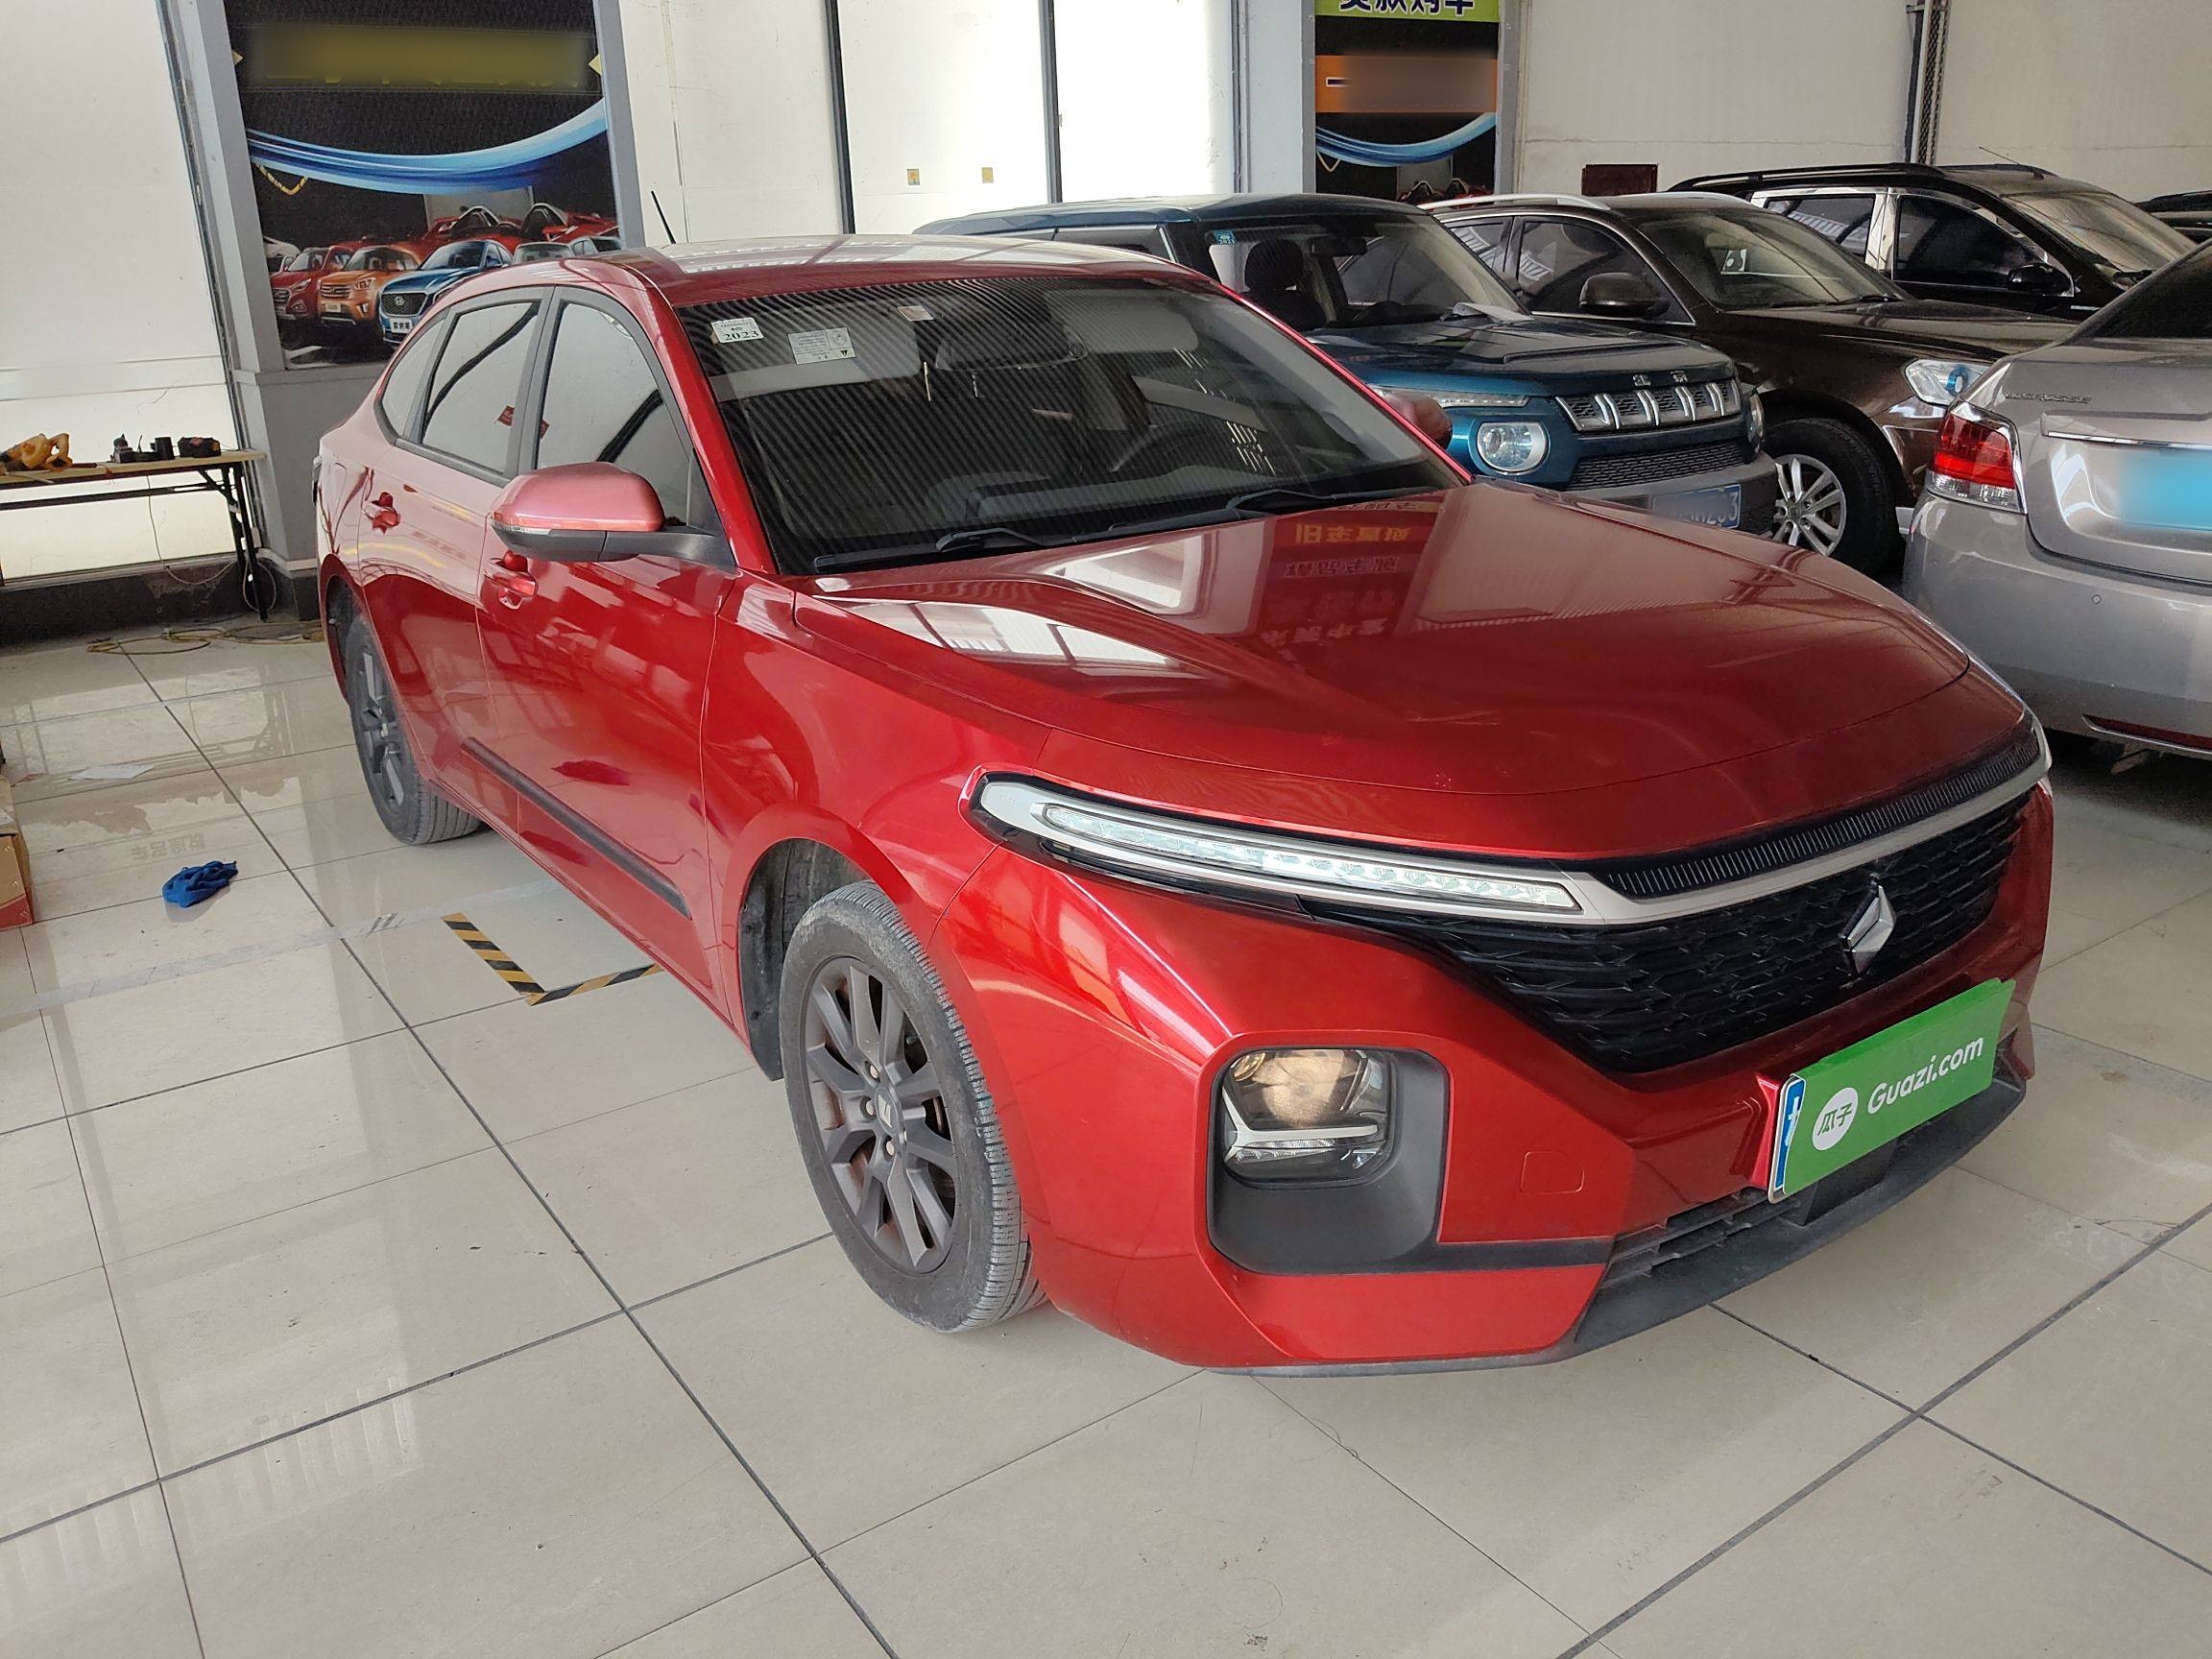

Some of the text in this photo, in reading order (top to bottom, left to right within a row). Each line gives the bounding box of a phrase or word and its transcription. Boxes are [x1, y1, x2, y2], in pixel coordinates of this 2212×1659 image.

[724, 330, 759, 341] 2023
[1867, 1037, 1984, 1115] Guazi.com
[1817, 1102, 1853, 1136] 瓜子
